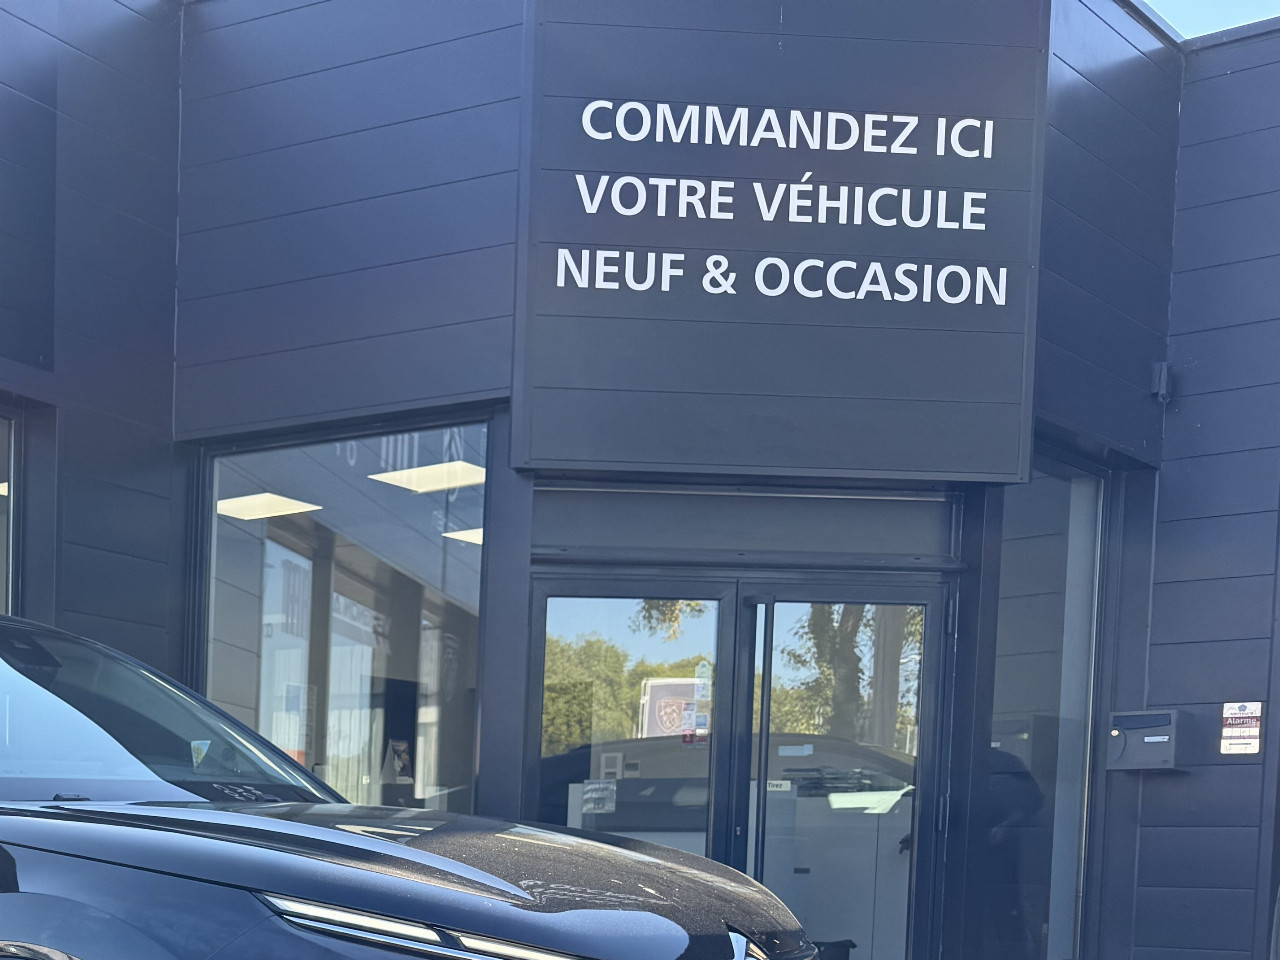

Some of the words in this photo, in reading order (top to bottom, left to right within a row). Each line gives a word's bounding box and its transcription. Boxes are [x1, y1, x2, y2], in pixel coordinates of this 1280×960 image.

[581, 100, 919, 154] COMMANDEZ
[935, 118, 994, 158] ICI
[575, 174, 735, 220] VOTRE
[753, 172, 987, 230] VÉHICULE
[556, 248, 685, 292] NEUF
[702, 254, 737, 295] &
[754, 257, 1007, 305] OCCASION
[1227, 717, 1257, 725] Alarme
